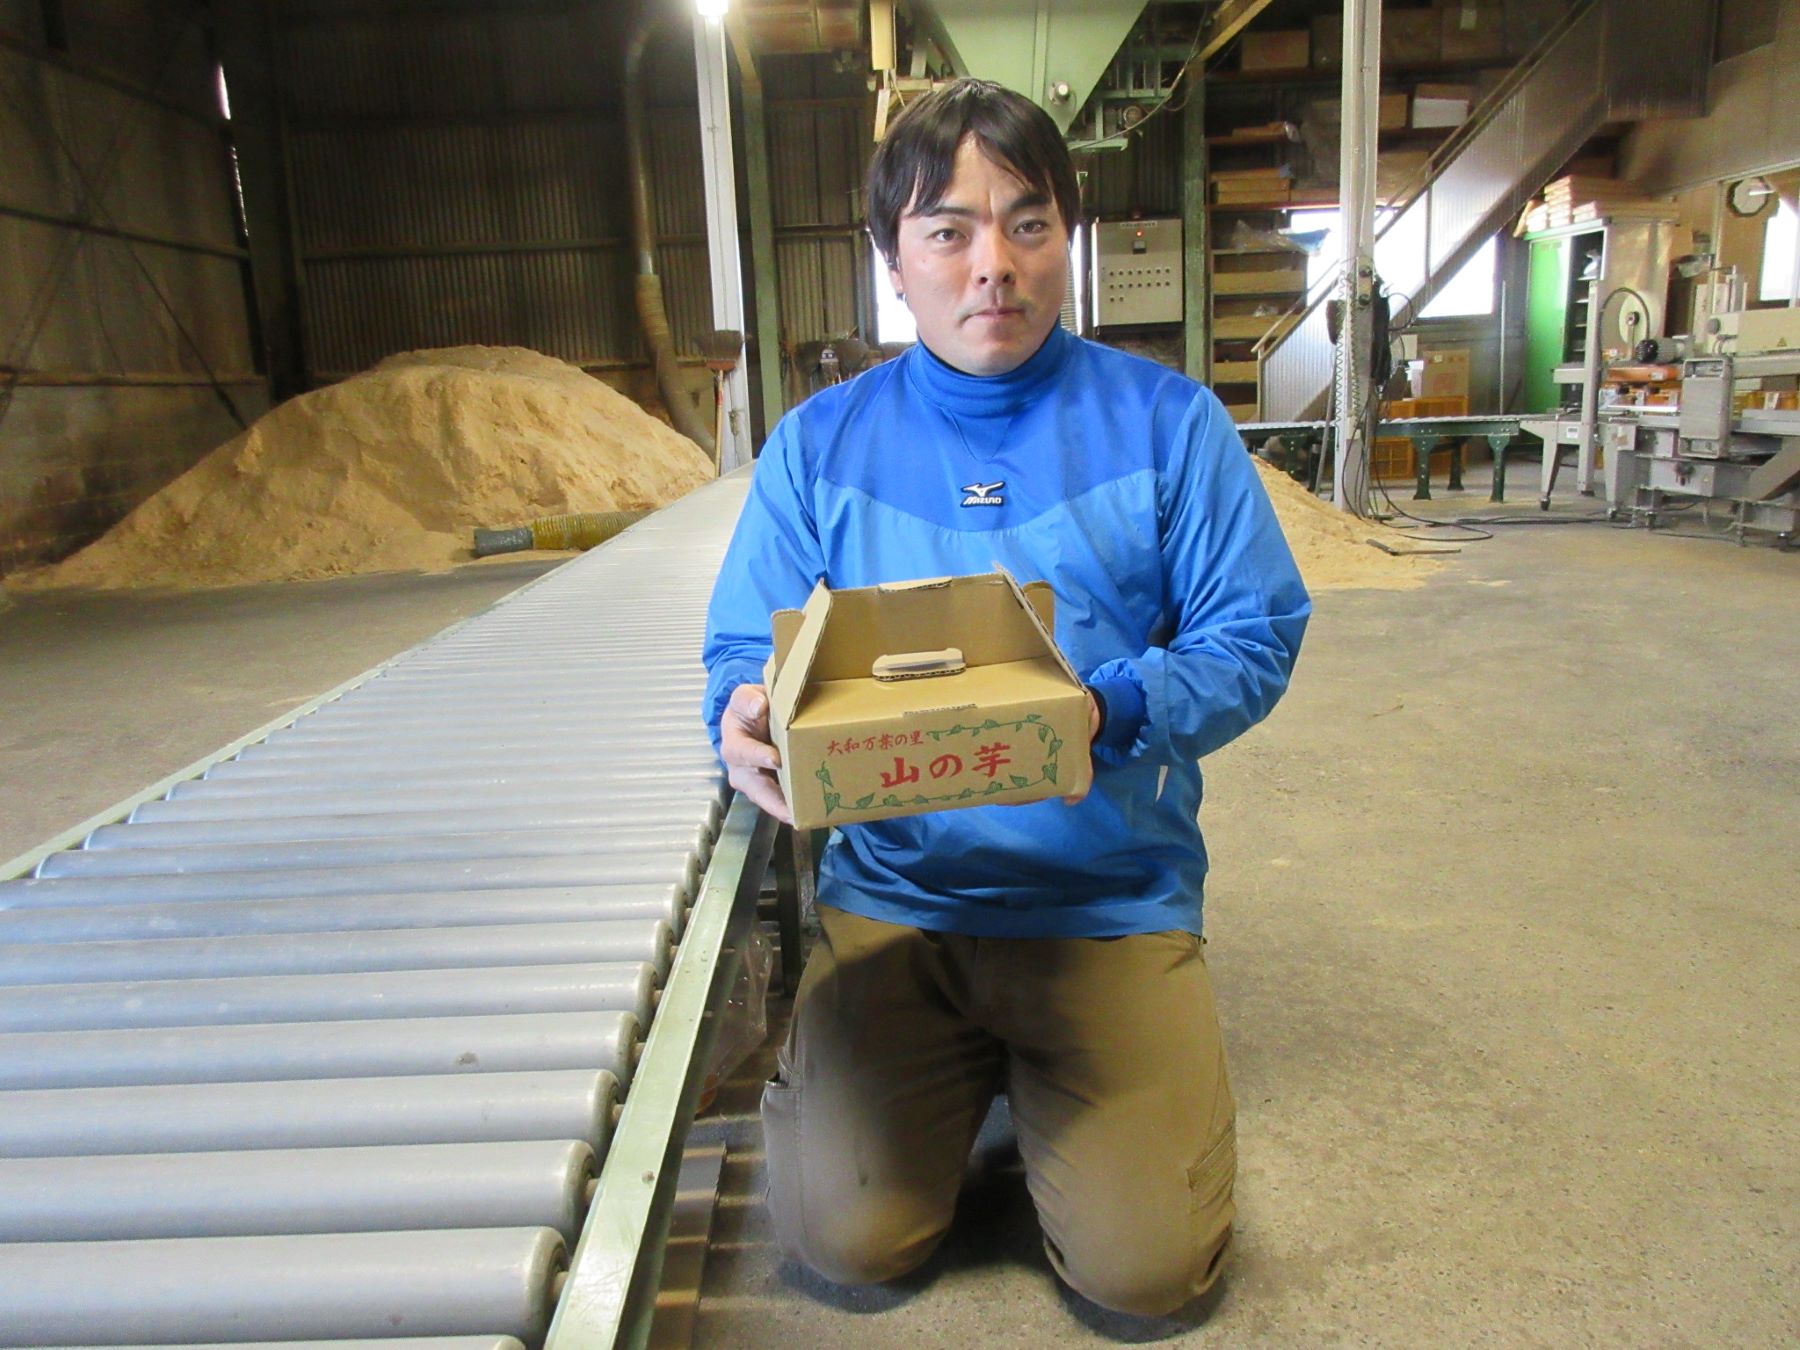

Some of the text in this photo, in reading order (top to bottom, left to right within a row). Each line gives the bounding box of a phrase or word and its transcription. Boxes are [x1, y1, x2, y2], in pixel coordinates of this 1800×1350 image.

[827, 730, 924, 756] 大和万葉の里
[880, 742, 1011, 789] 山の芋
